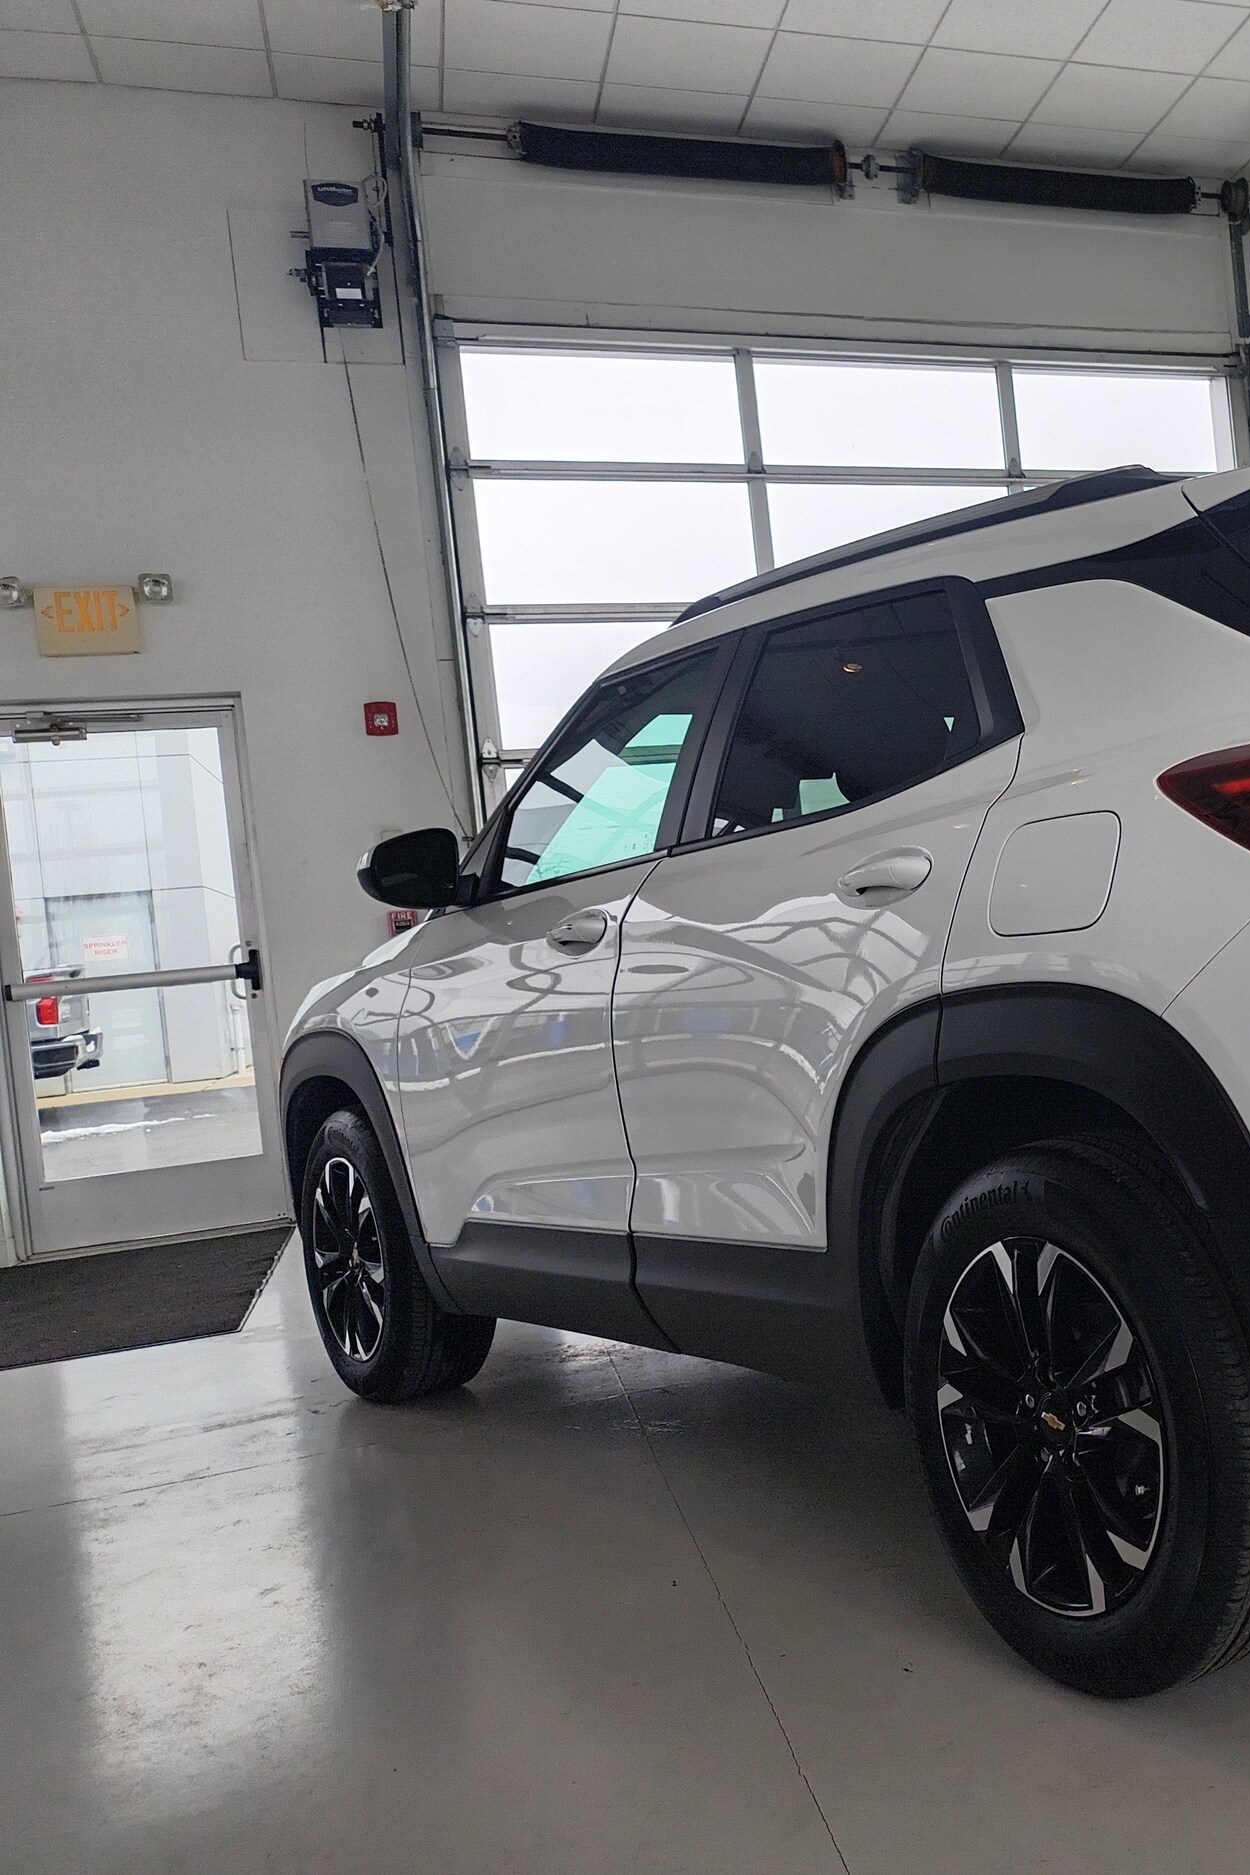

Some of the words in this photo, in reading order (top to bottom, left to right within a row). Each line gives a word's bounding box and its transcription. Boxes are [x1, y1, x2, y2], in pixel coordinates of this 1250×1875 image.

[54, 591, 118, 633] EXIT
[391, 911, 413, 920] FIRE
[83, 940, 127, 949] SPRINKLER
[940, 1180, 1018, 1243] Continental
